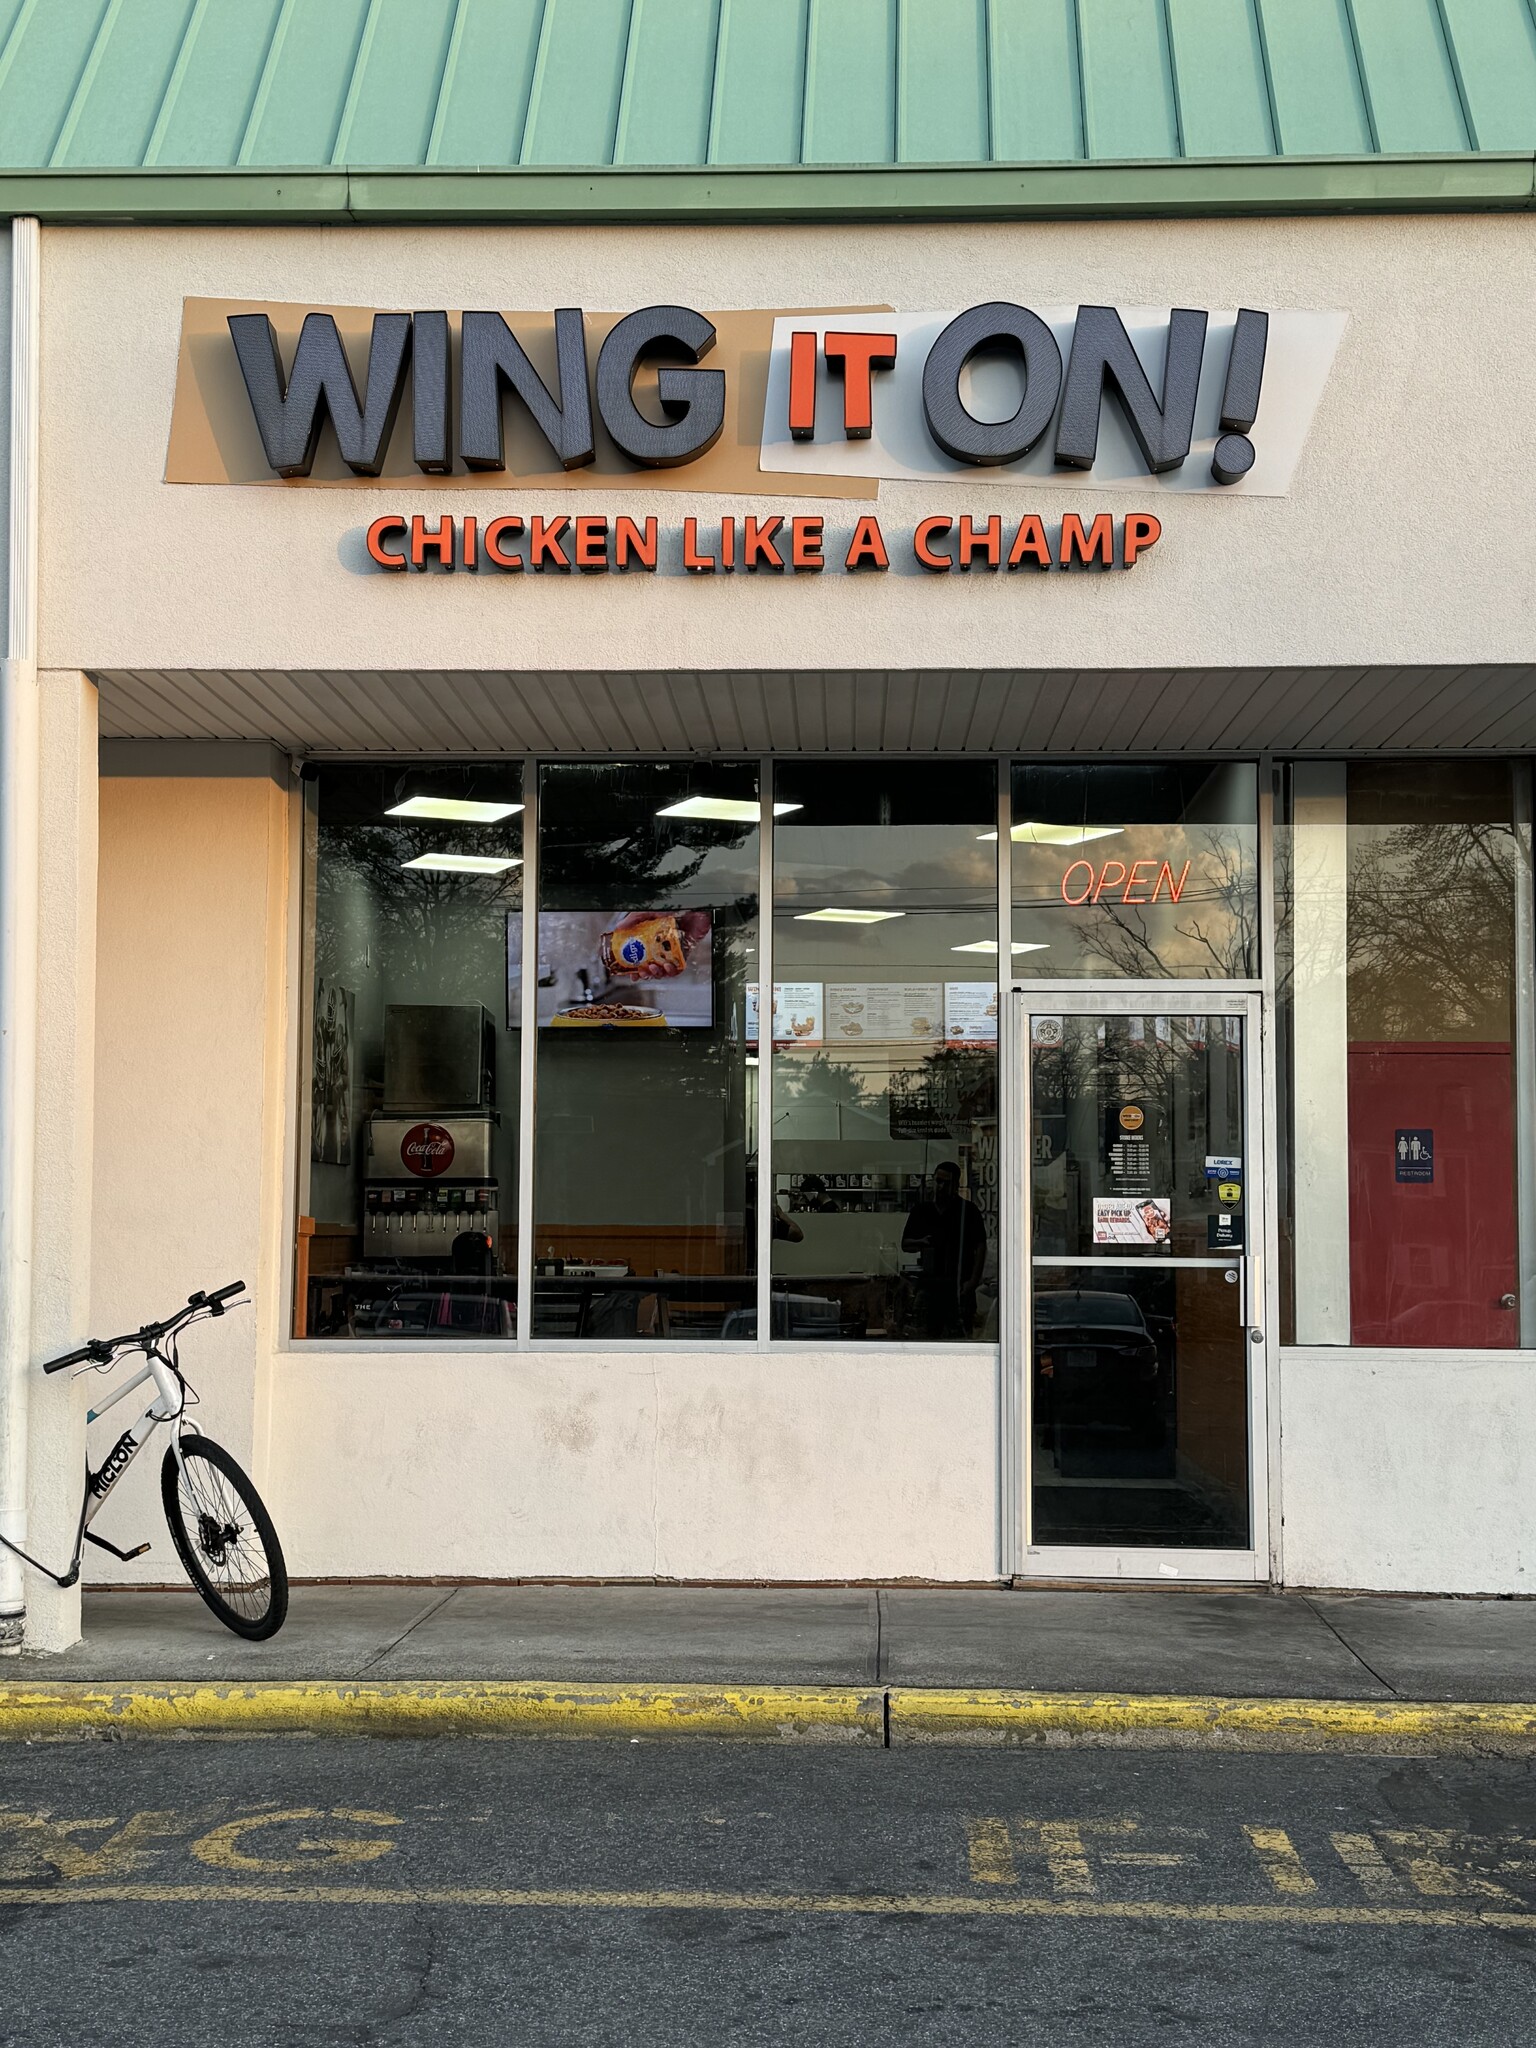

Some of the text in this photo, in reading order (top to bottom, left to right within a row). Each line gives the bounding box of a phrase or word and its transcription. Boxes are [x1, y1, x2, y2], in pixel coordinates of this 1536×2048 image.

[227, 301, 1269, 485] WING IT ON!
[366, 512, 1162, 573] CHICKEN LIKE A CHAMP
[1061, 860, 1192, 905] OPEN
